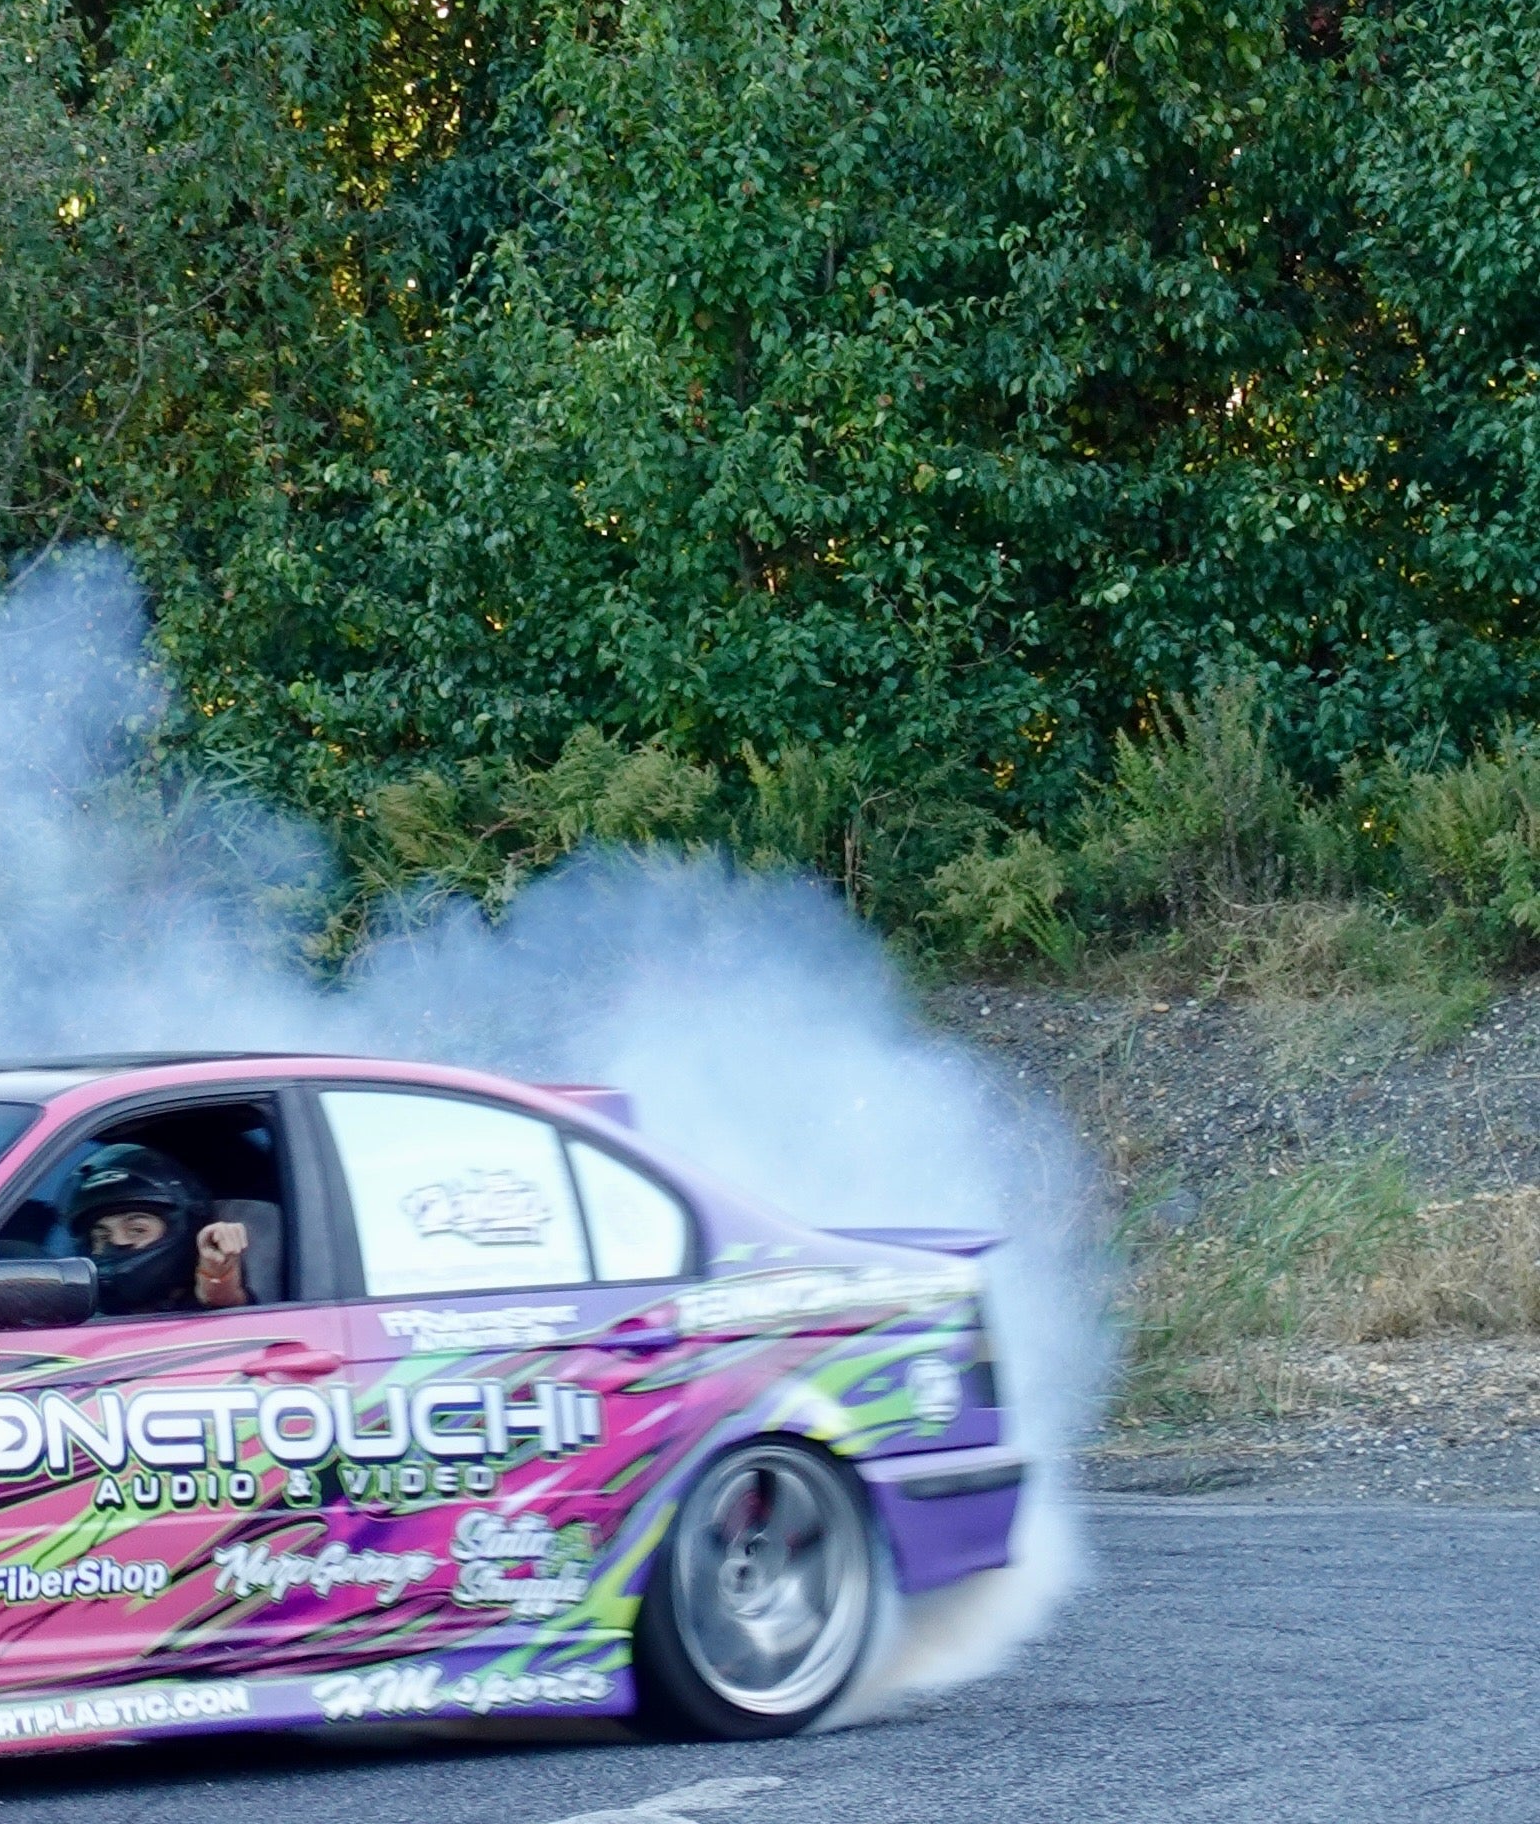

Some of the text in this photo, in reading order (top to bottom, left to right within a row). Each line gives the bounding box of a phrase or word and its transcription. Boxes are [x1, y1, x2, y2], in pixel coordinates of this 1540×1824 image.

[94, 1466, 495, 1509] AUDIO & VIDEO
